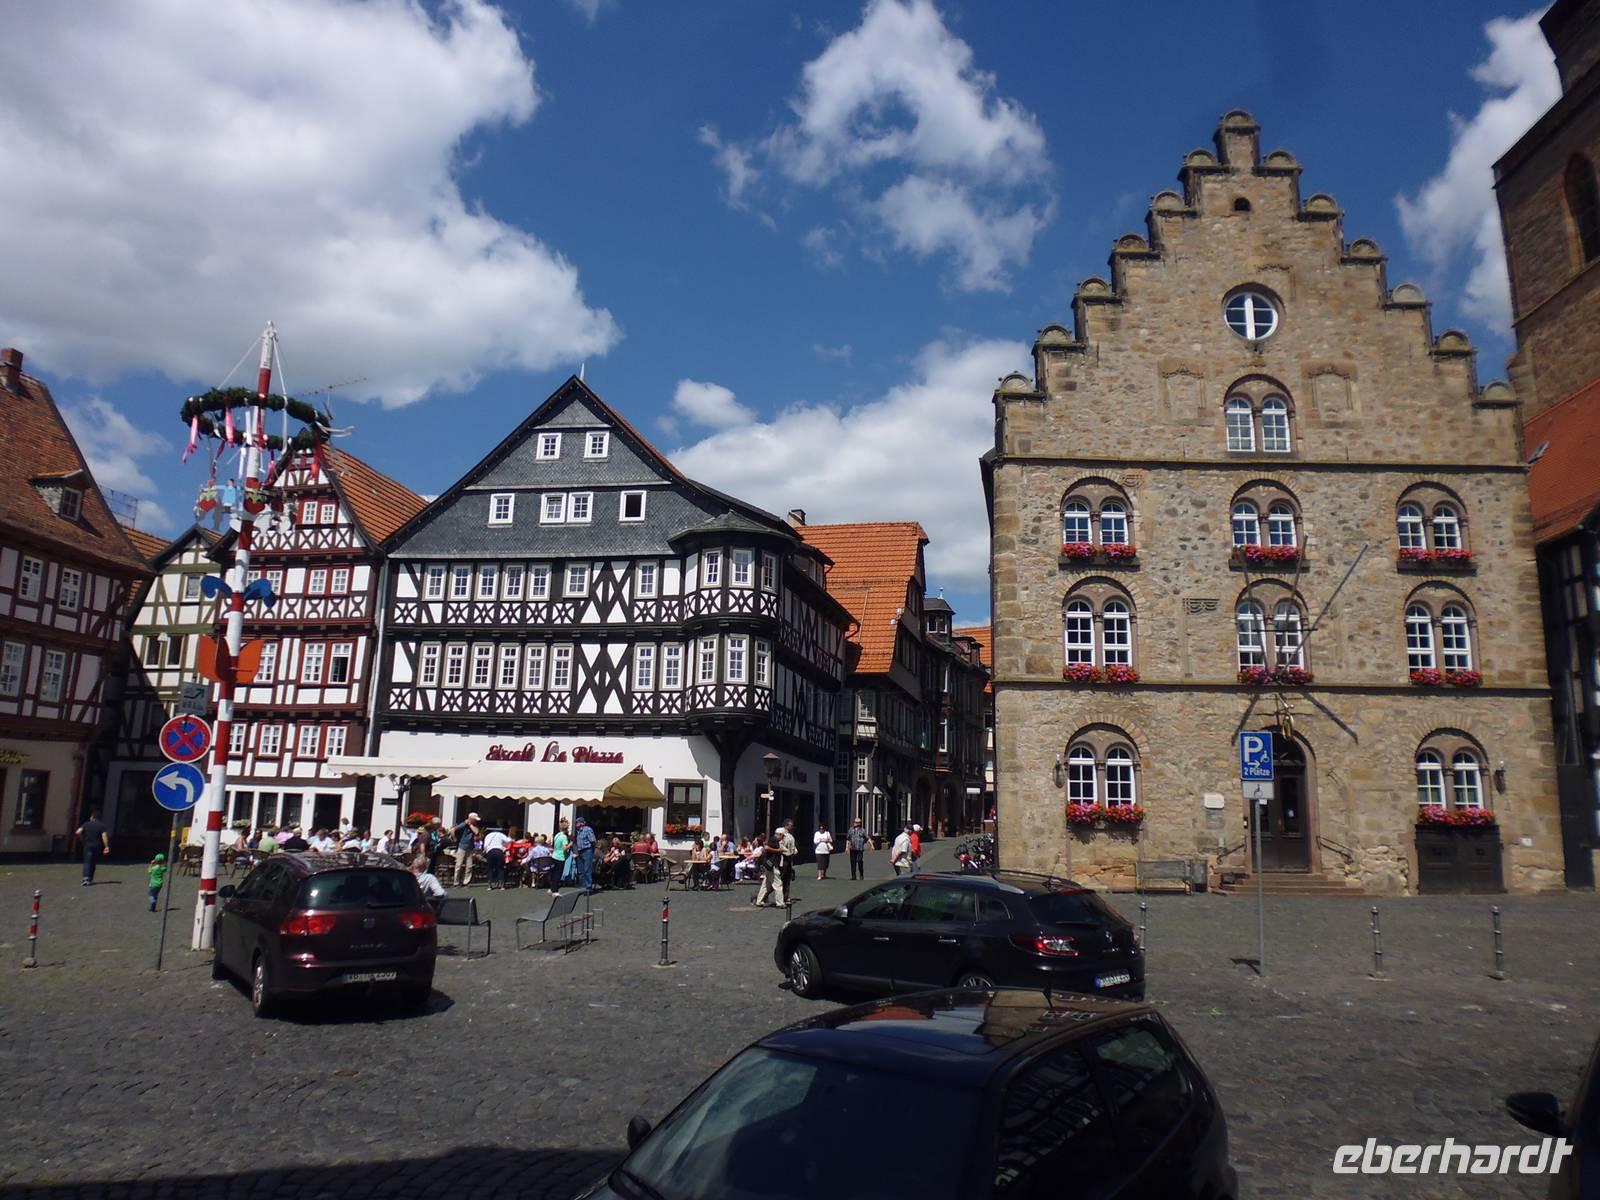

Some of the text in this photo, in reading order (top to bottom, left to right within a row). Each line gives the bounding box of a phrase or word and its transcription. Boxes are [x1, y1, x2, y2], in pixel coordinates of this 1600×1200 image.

[541, 740, 567, 762] La
[572, 745, 624, 763] Piazza
[1244, 736, 1263, 763] P
[1244, 767, 1271, 777] 2 Plätze
